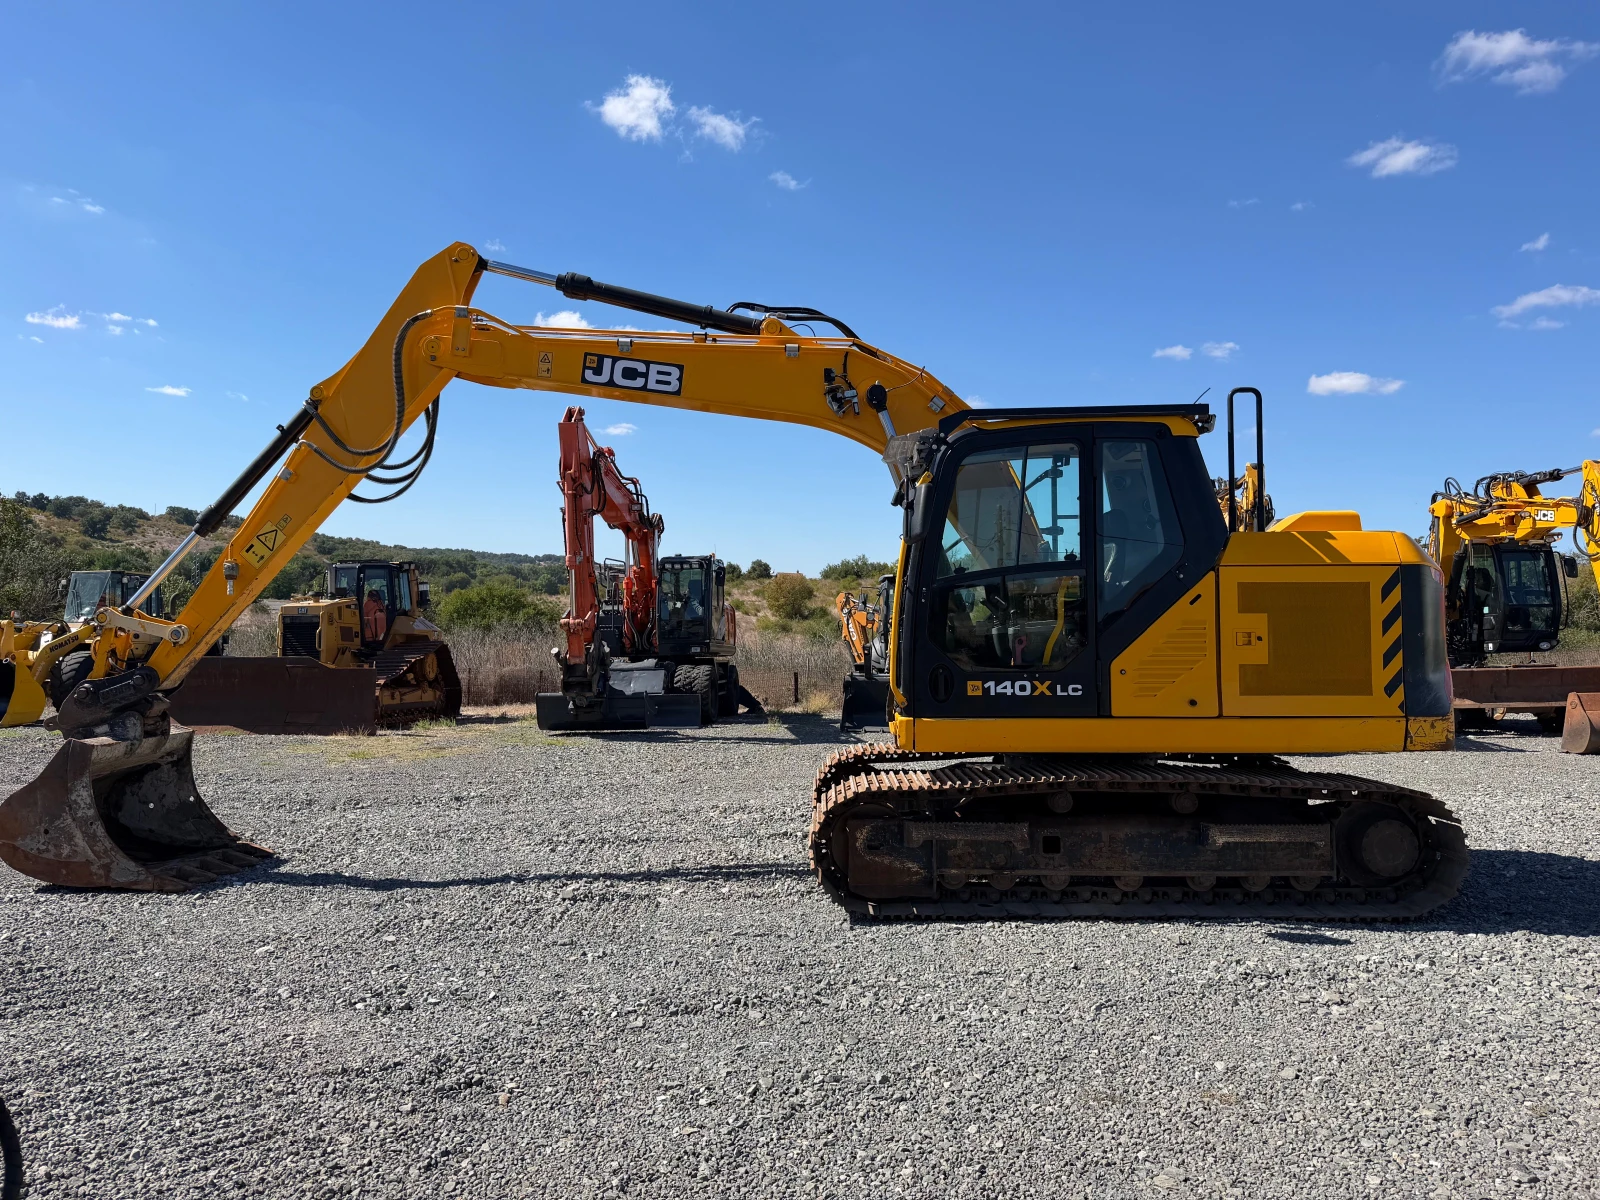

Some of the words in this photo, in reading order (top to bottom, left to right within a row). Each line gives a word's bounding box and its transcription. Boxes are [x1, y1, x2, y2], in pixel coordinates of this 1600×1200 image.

[585, 358, 680, 392] JCB
[1535, 510, 1554, 521] JCB
[50, 635, 79, 652] KOMATSU
[983, 680, 1053, 696] 140X
[1056, 684, 1083, 696] LC
